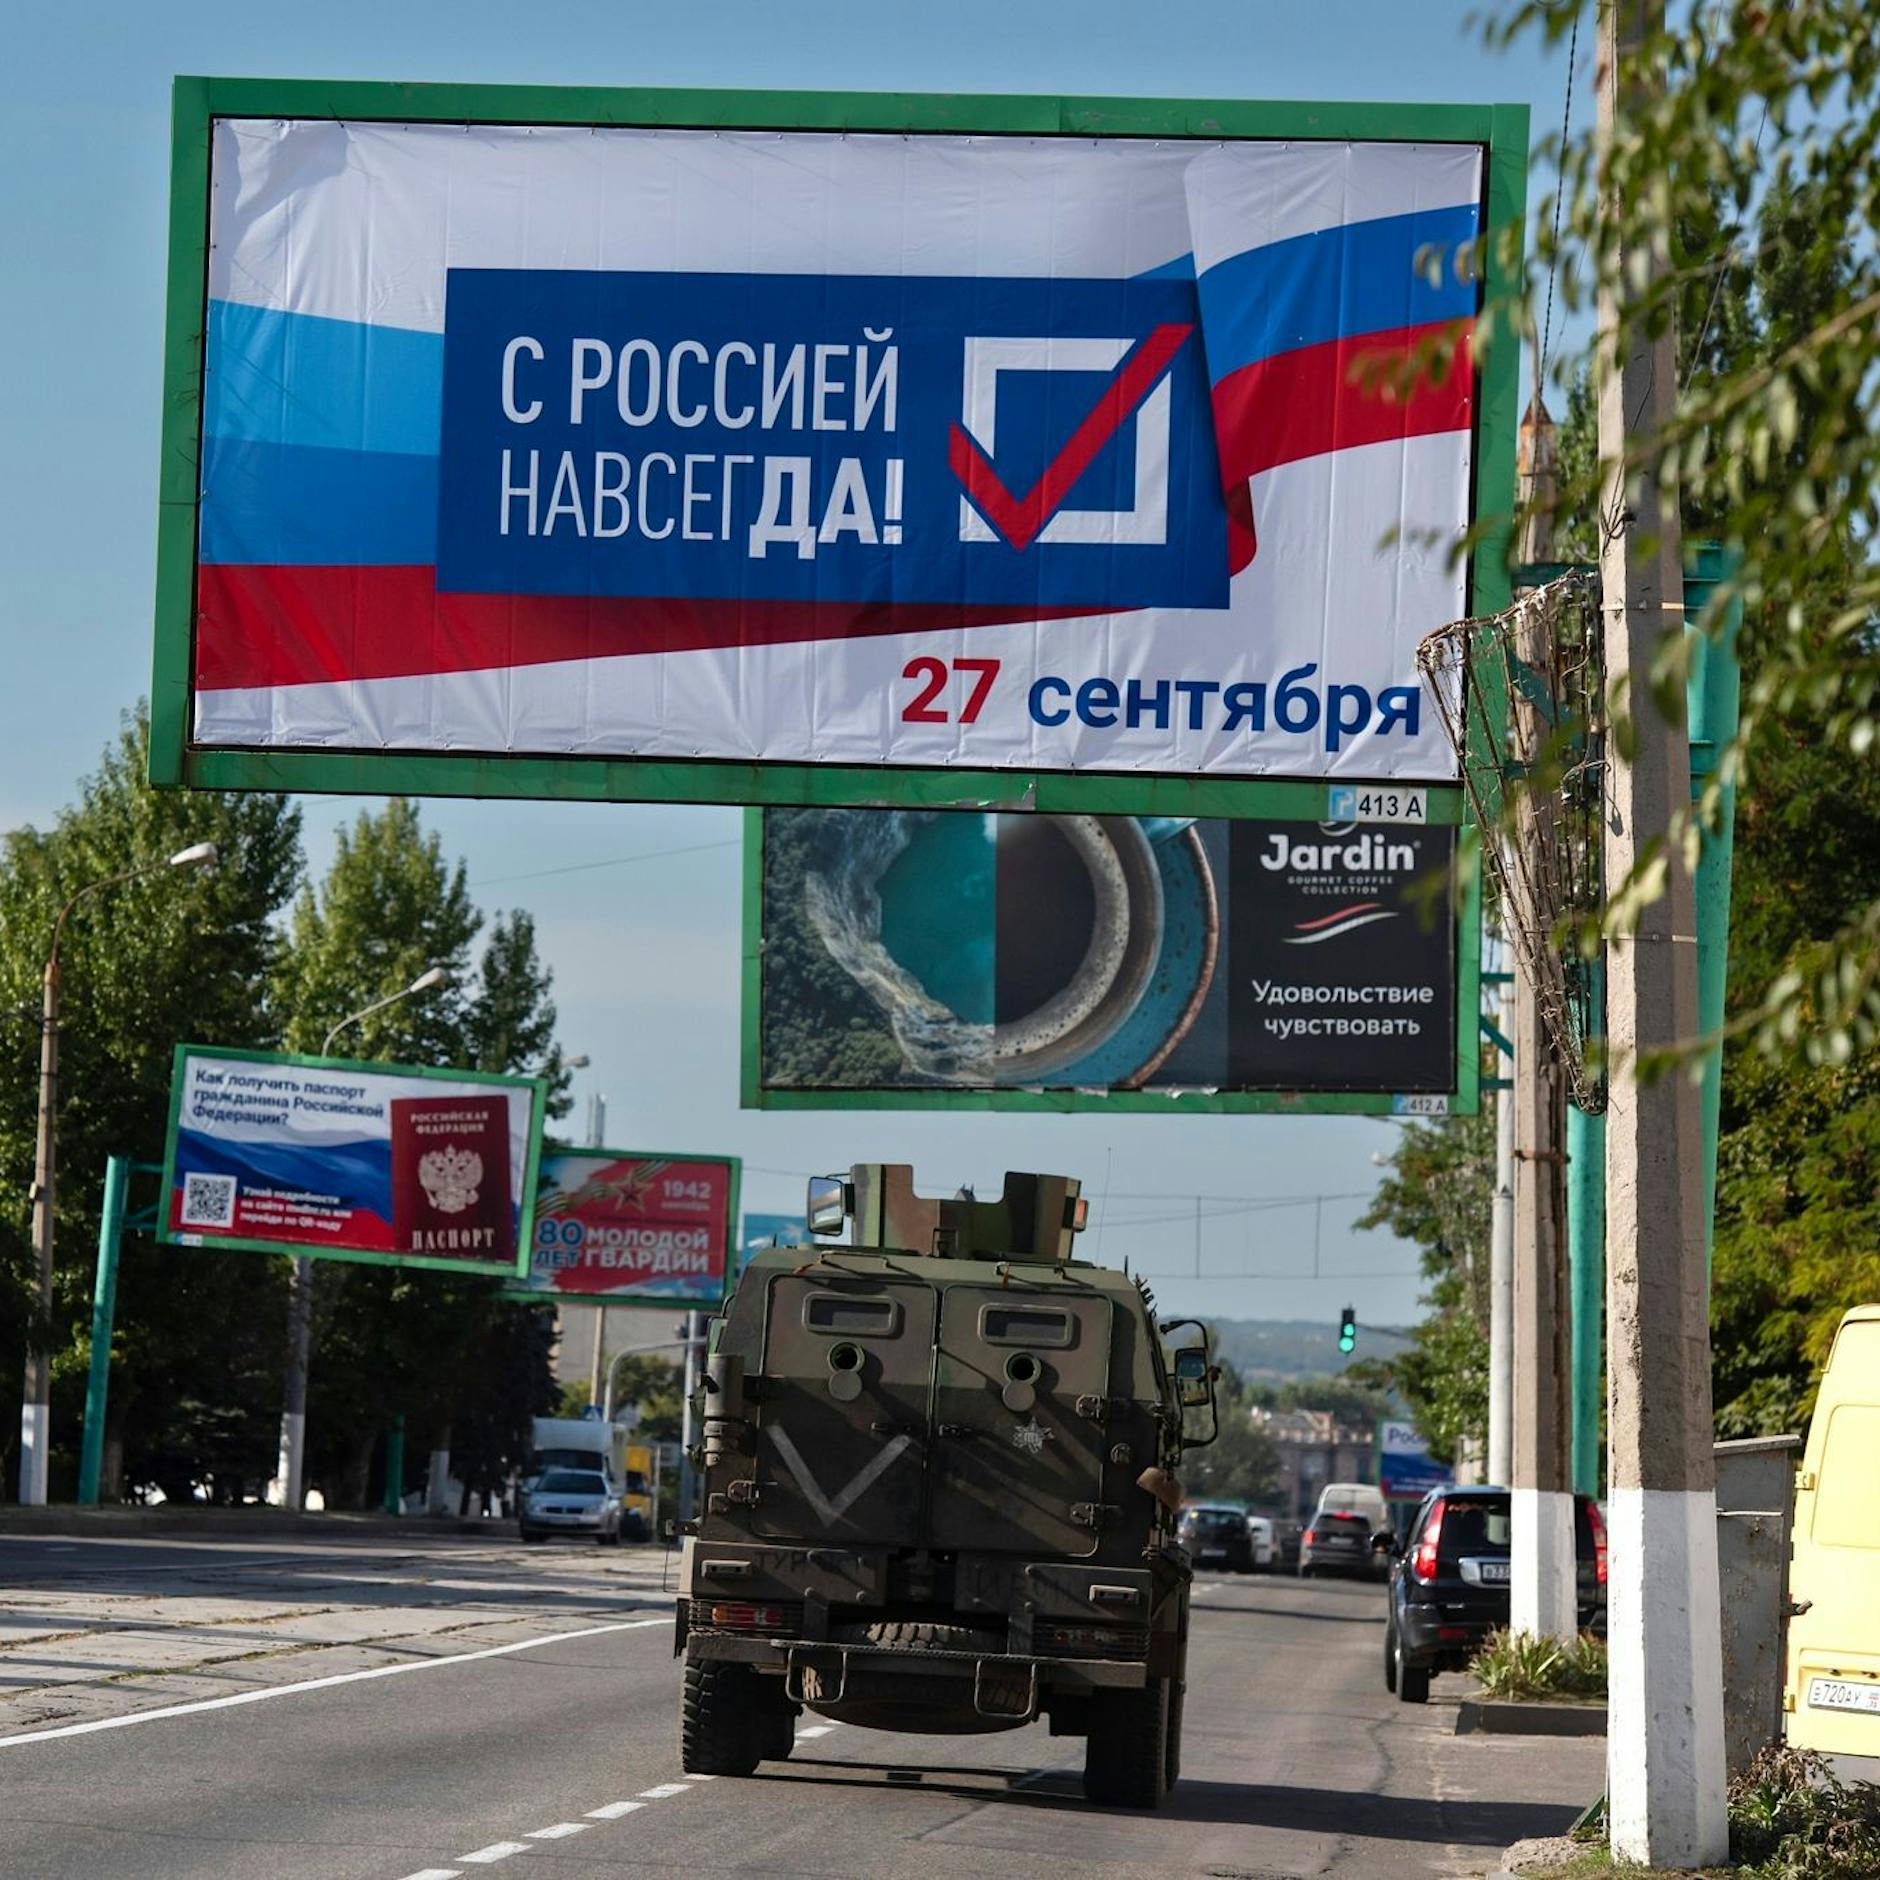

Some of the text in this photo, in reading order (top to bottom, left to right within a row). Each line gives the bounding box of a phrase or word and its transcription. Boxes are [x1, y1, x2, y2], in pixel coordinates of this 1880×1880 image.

[502, 327, 898, 432] С РОССИЕЙ
[500, 448, 904, 559] НАВСЕГДА!
[902, 656, 1420, 752] 27 сентября
[1358, 795, 1399, 817] 413
[1260, 833, 1415, 871] Jardin
[1287, 875, 1394, 885] GOURMET COFFEE
[1302, 885, 1379, 895] COLLECTION
[1251, 979, 1434, 1005] Удовольствие
[1264, 1017, 1421, 1040] чувствовать
[195, 1069, 366, 1101] Как получить паспорт
[192, 1104, 289, 1125] Федерации?
[194, 1088, 384, 1118] гражданина Российской
[1410, 1097, 1433, 1113] 412
[410, 1110, 489, 1123] РОССИЙСКАЯ
[415, 1122, 485, 1135] ФЕДЕРАЦИЯ
[662, 1179, 712, 1199] 1942
[411, 1227, 495, 1250] ПАСПОРТ
[537, 1217, 709, 1250] 80 МОЛОДОЙ
[534, 1248, 709, 1273] ЛЕТ ГВАРДИИ
